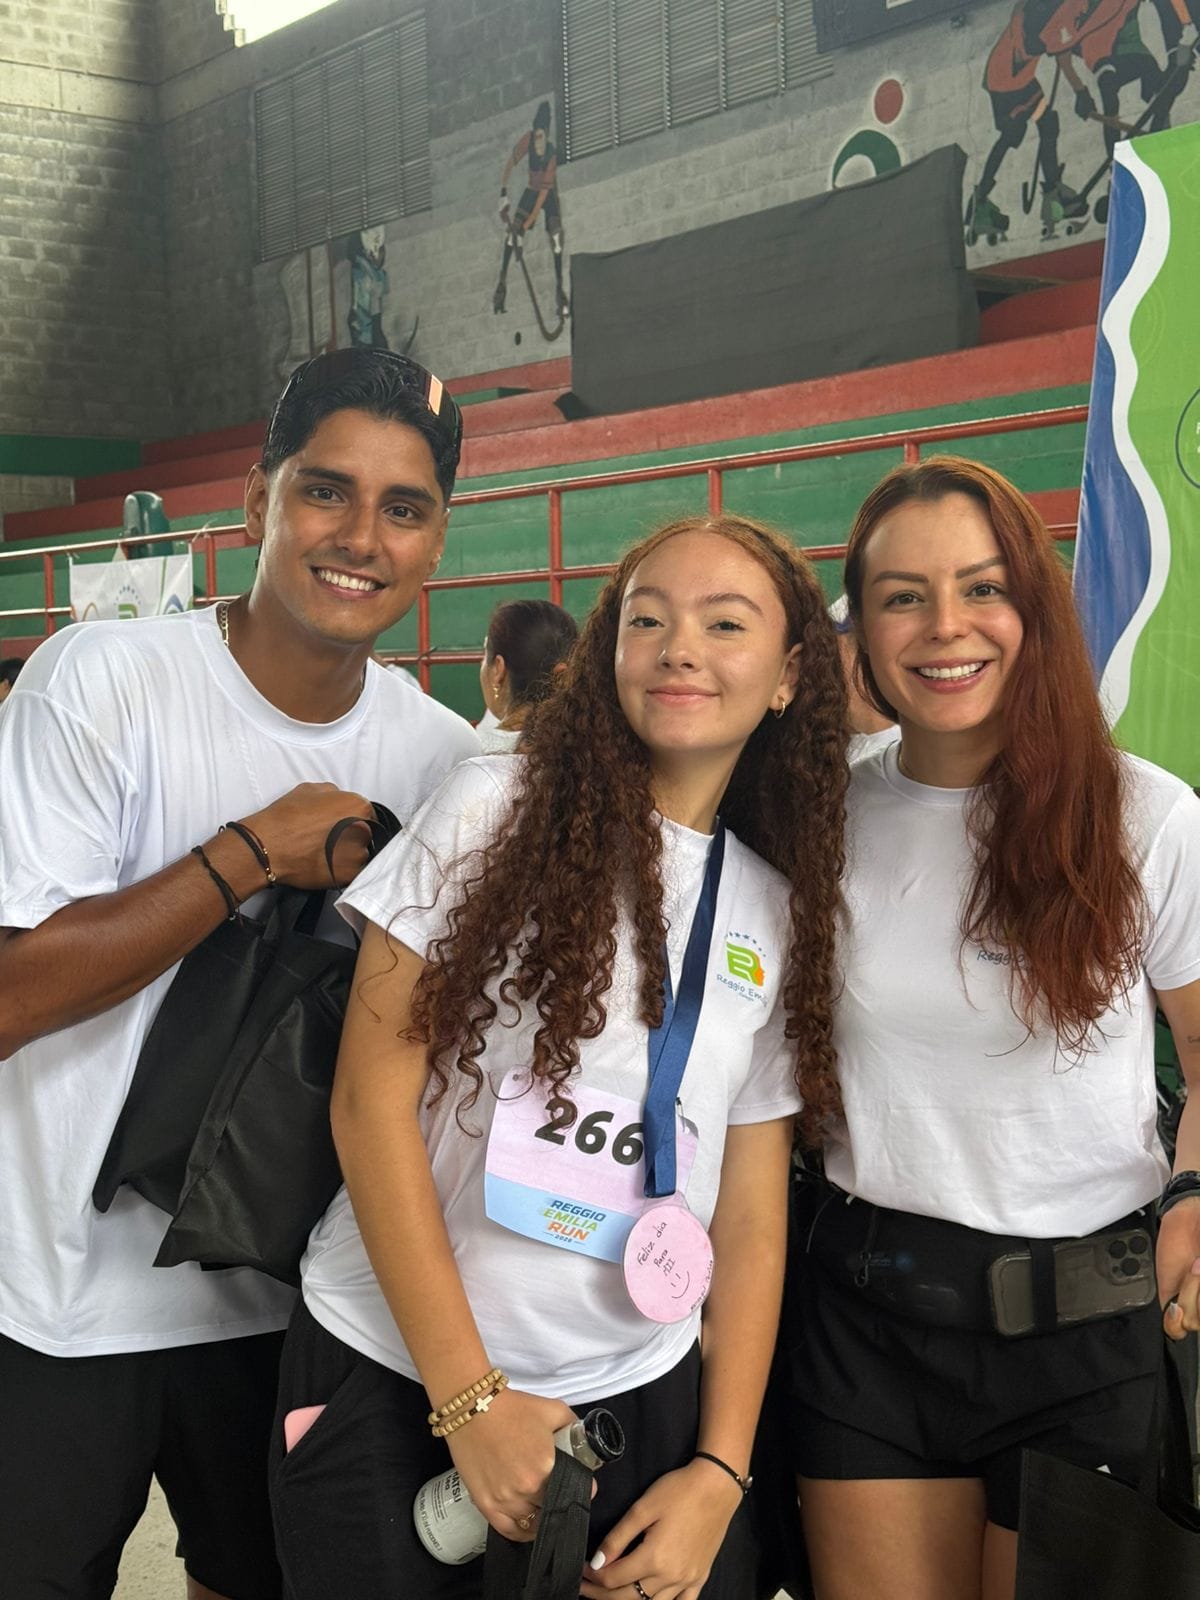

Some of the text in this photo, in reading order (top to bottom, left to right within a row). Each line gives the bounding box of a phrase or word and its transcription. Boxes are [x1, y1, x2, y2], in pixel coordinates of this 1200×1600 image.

[976, 949, 1024, 966] Reggo
[716, 973, 746, 993] Reggio
[534, 1097, 644, 1166] 266
[543, 1208, 599, 1232] EMILIA
[551, 1200, 607, 1222] REGGIO
[547, 1221, 590, 1241] RUN
[637, 1241, 656, 1266] Feliz
